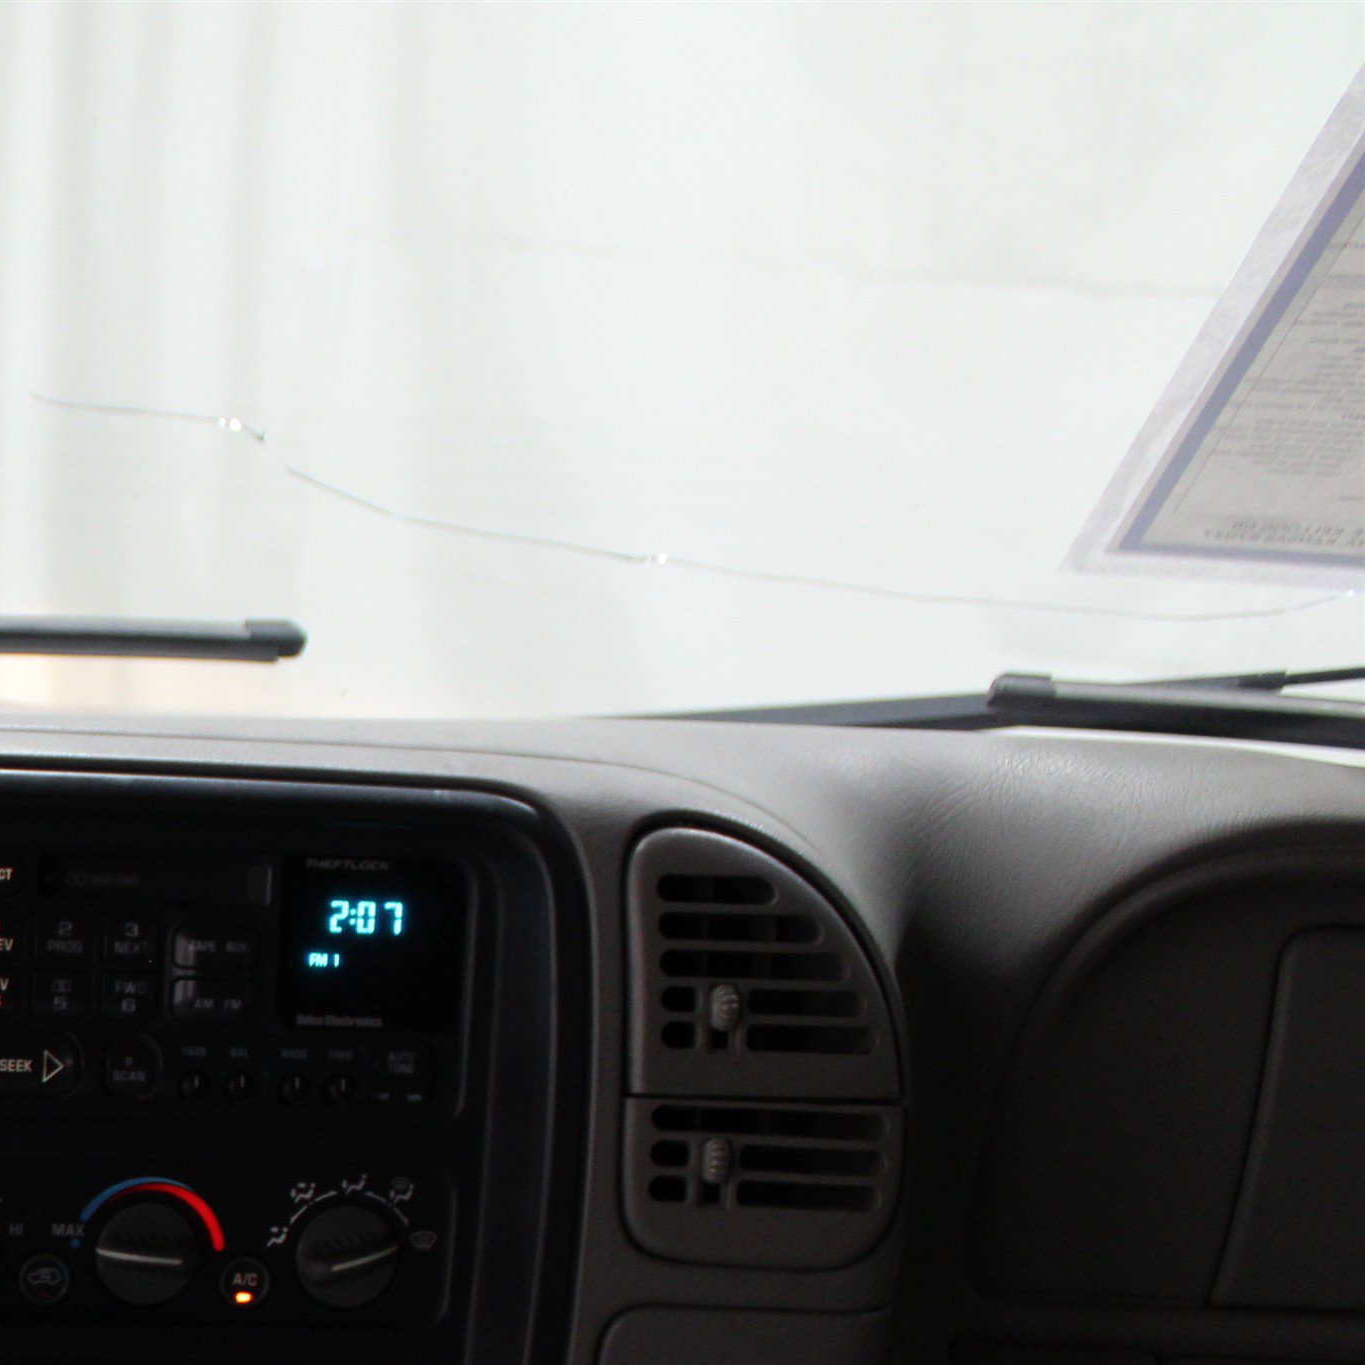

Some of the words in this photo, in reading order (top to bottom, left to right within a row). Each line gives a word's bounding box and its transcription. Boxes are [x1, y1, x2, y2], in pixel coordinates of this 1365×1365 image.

[306, 859, 390, 871] THEFTLOCK
[329, 899, 404, 936] 2:07
[57, 920, 73, 937] 2
[124, 921, 140, 938] 3
[48, 939, 83, 954] PROG
[114, 940, 147, 955] NEXT
[308, 952, 329, 968] FM
[332, 952, 341, 968] 1
[52, 996, 68, 1012] 5
[120, 997, 136, 1013] 6
[9, 1223, 25, 1236] HI
[52, 1222, 85, 1237] MAX
[232, 1272, 258, 1287] A/C
